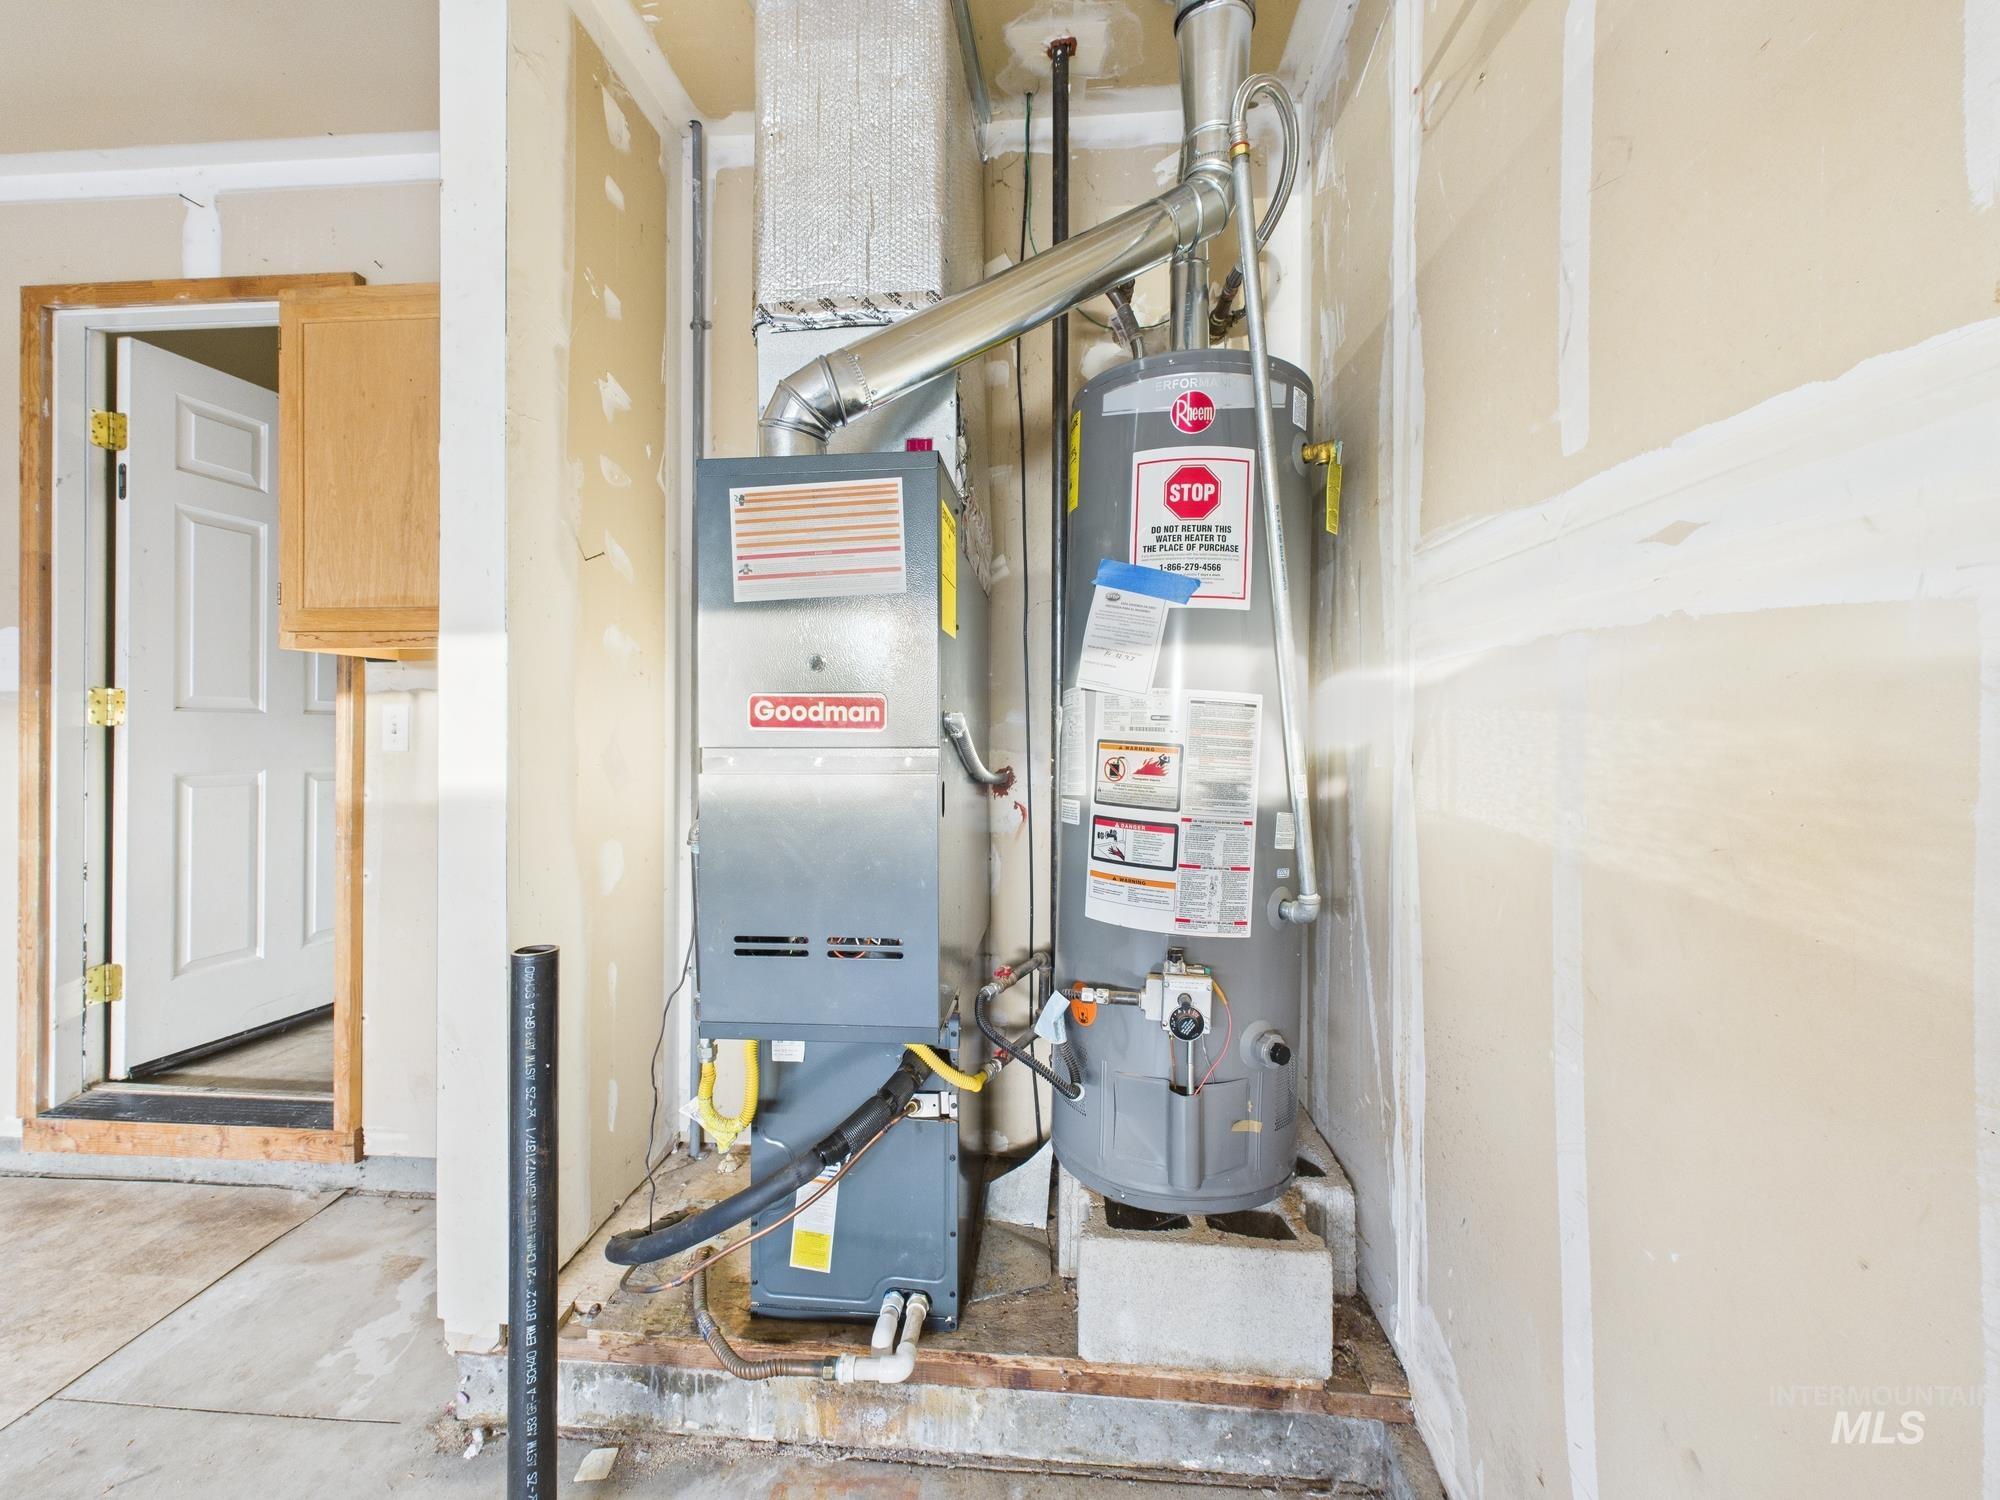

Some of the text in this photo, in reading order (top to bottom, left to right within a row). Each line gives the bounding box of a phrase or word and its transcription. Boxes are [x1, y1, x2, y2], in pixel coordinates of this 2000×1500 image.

[1175, 391, 1213, 427] Rheem
[1169, 484, 1216, 503] STOP
[1151, 524, 1232, 534] DO NOT RETURN THIS
[1155, 534, 1227, 543] WATER HEATER TO
[1142, 543, 1239, 553] THE PLACE OF PURCHASE
[1159, 562, 1222, 572] 1-866-279-4566
[754, 701, 880, 723] Goodman
[1124, 745, 1156, 753] WARNING
[1120, 823, 1146, 831] DANGER
[1119, 877, 1146, 886] WARNING
[525, 966, 535, 999] SCH40
[525, 1002, 535, 1030] GR-A
[525, 1055, 536, 1081] ASTM
[526, 1299, 537, 1321] BTC
[526, 1350, 538, 1385] SCH40
